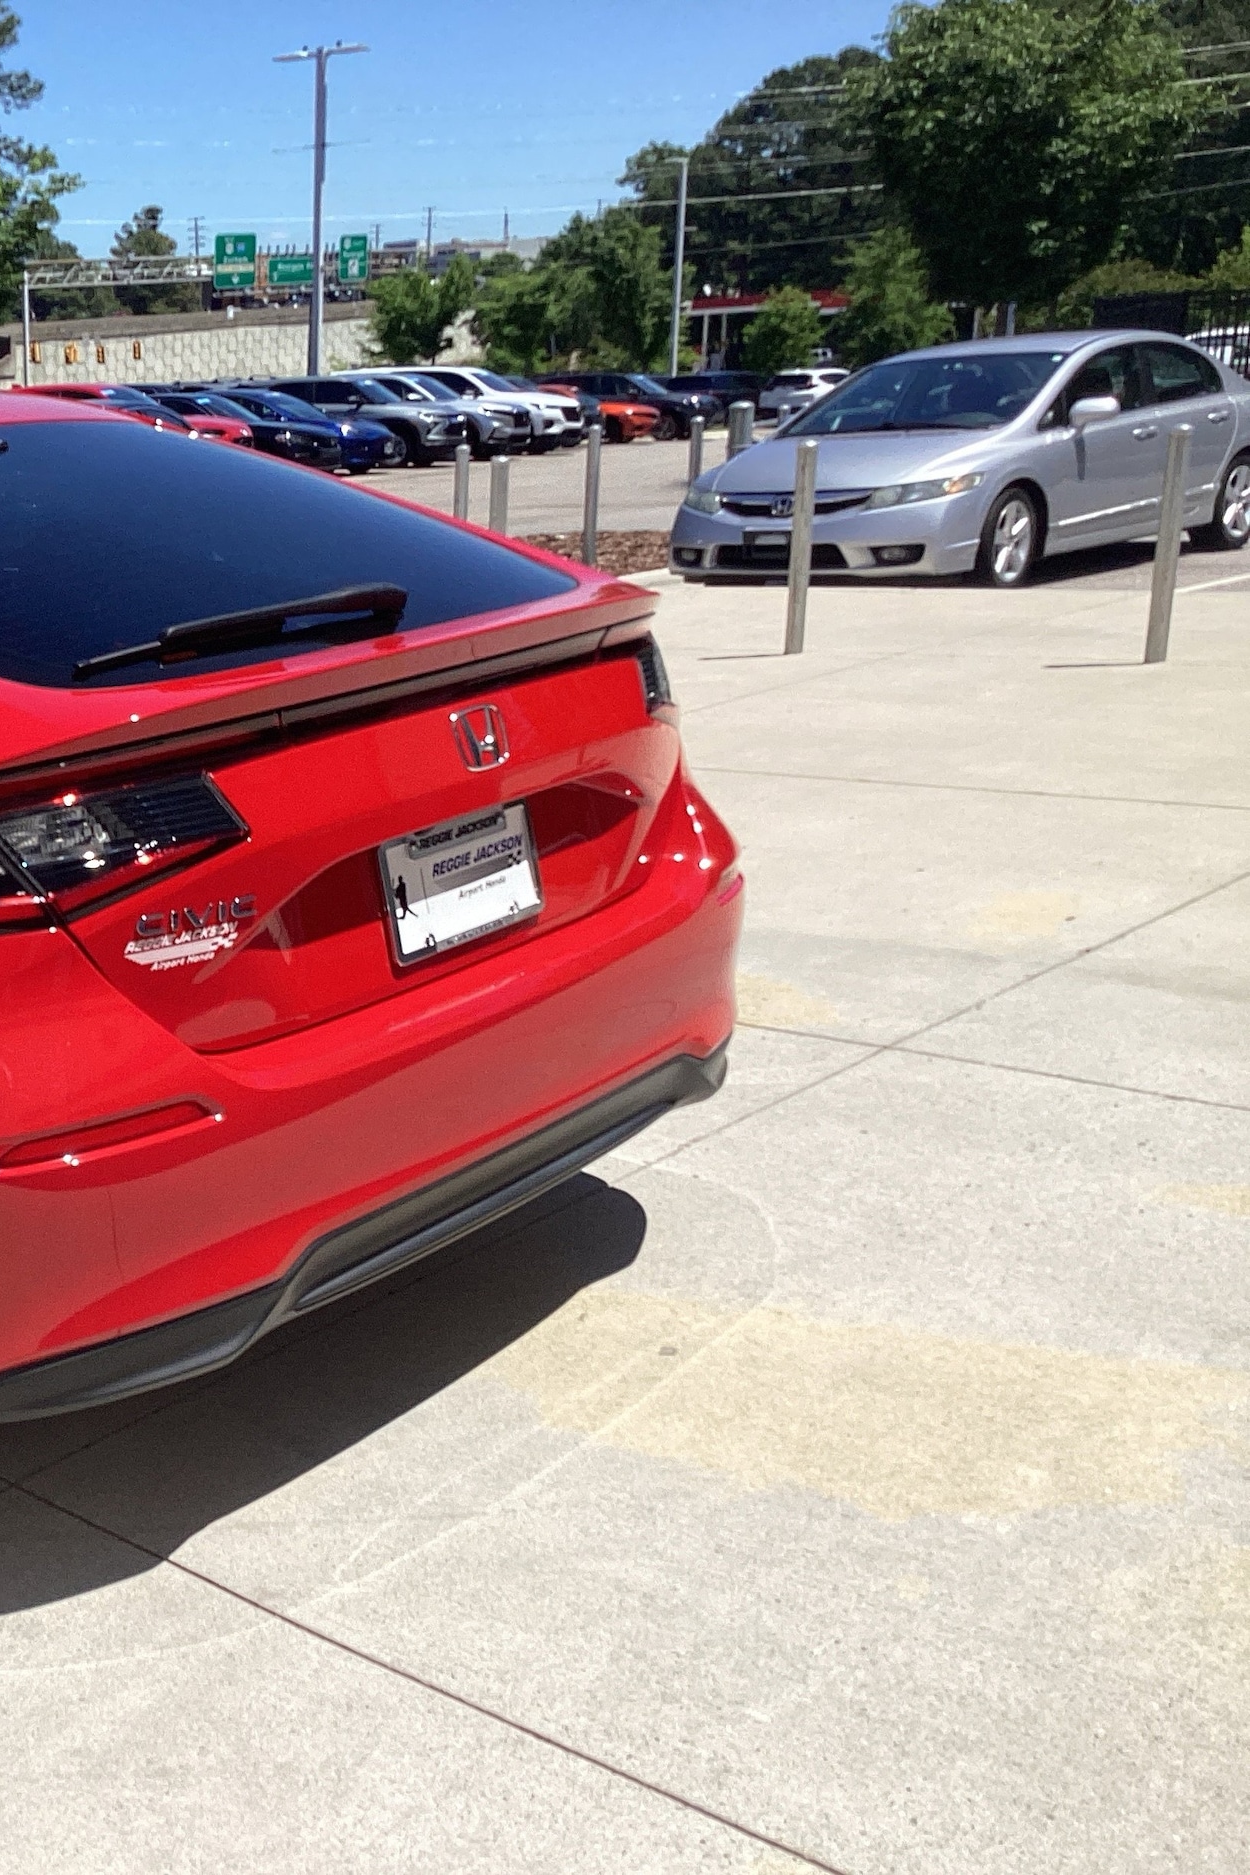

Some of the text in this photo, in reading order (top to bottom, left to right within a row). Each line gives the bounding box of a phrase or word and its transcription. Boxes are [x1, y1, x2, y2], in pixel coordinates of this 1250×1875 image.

[419, 814, 499, 850] REGGIE JACKSON
[433, 834, 521, 876] REGGIE JACKSON
[136, 894, 257, 936] CIVIC
[175, 921, 238, 944] JACKSON
[151, 952, 215, 972] Airport Honda
